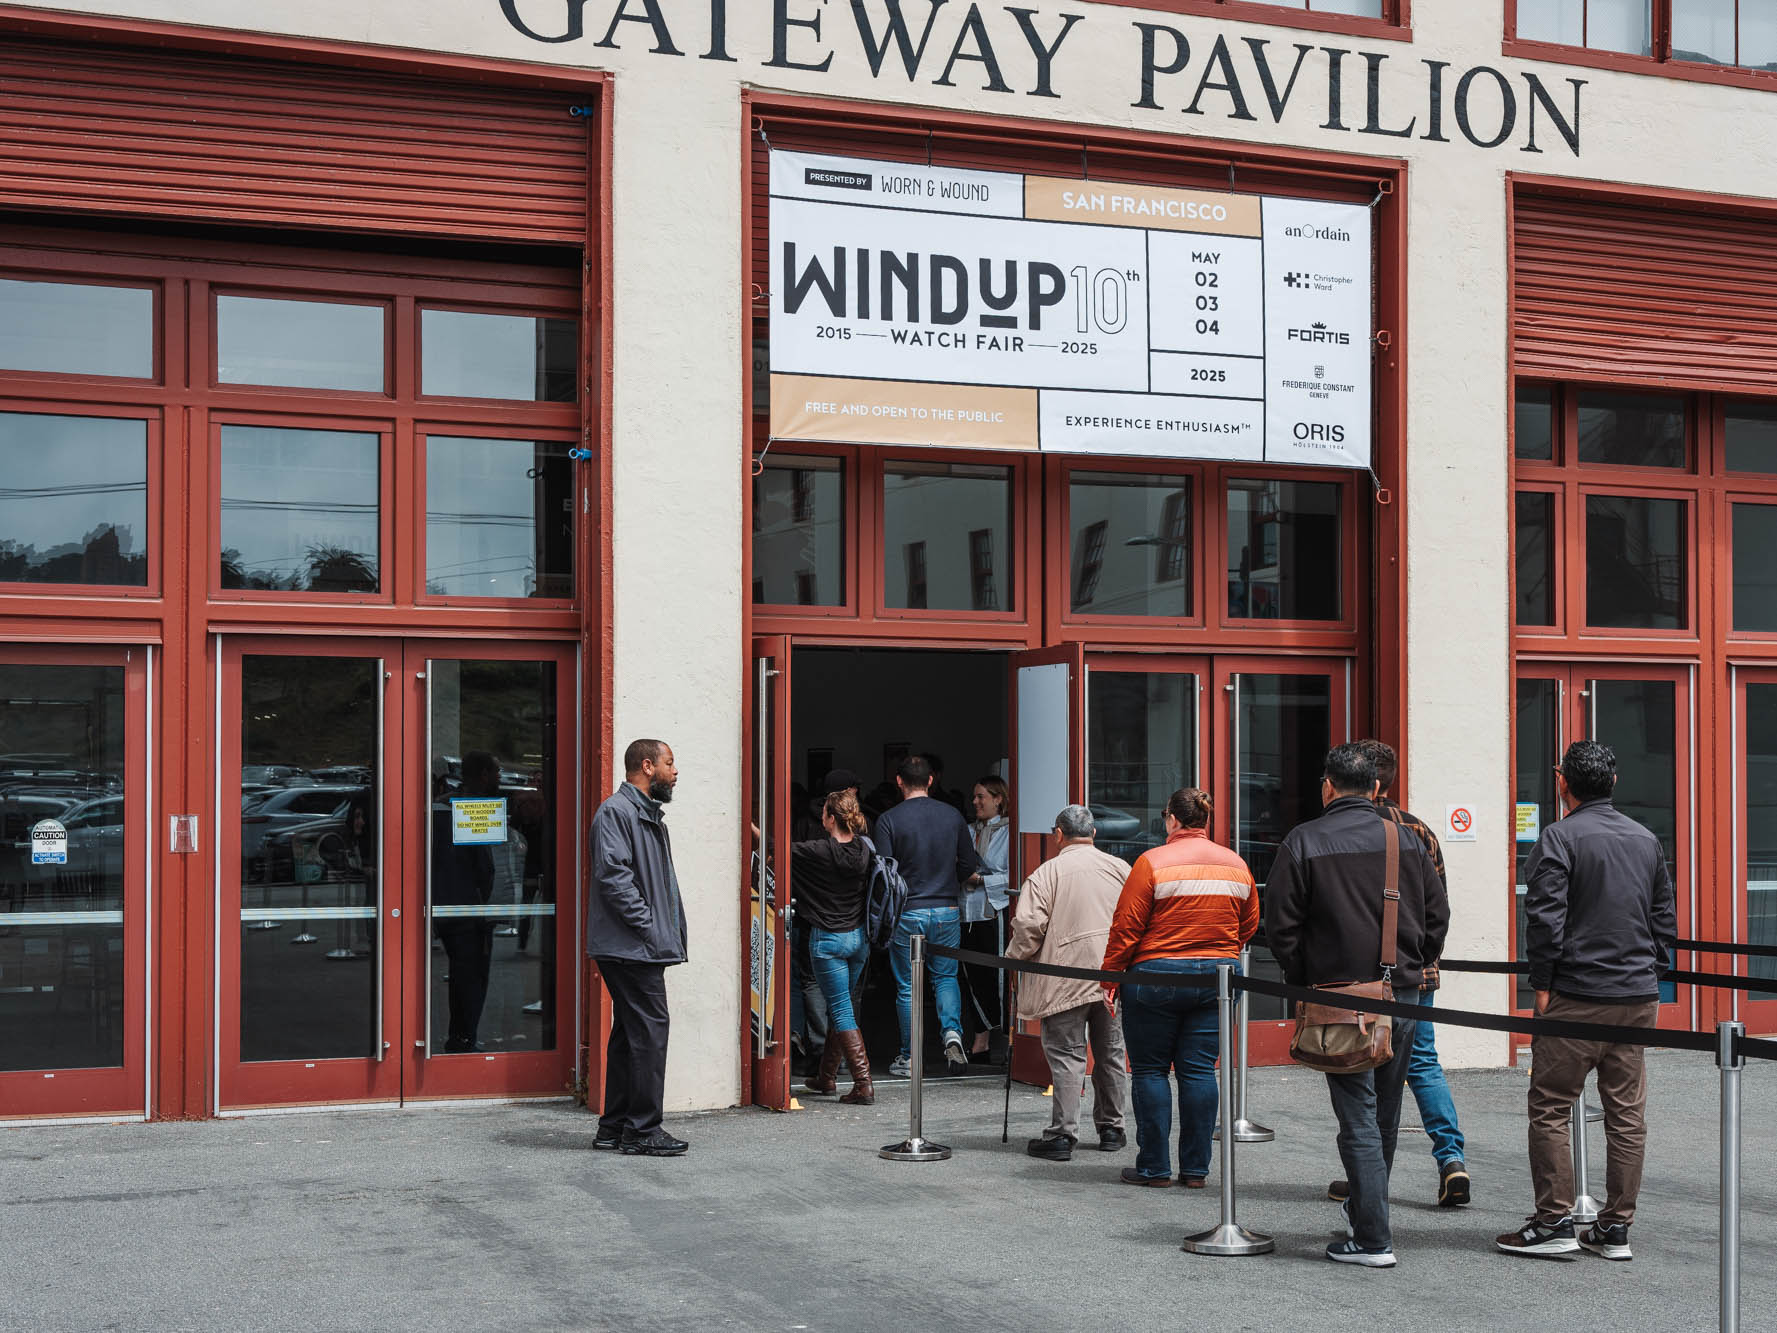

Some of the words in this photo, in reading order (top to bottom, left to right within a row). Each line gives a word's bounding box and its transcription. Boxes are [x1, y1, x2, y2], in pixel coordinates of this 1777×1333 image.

[1130, 21, 1589, 158] PAVILION
[810, 172, 855, 185] PRESENTED
[856, 176, 868, 186] BY
[881, 175, 922, 196] WORN
[927, 180, 936, 197] &
[940, 181, 989, 202] WOUND
[1062, 191, 1105, 212] SAN
[1111, 196, 1228, 222] FRANCISCO
[1191, 251, 1221, 265] MAY
[1194, 271, 1219, 288] 02
[1313, 274, 1353, 284] Christopher
[1313, 283, 1332, 291] Ward
[1195, 295, 1219, 312] 03
[1195, 319, 1220, 335] 04
[816, 325, 852, 340] 2015
[890, 328, 967, 349] WATCH
[976, 334, 1024, 352] FAIR
[1061, 341, 1098, 355] 2025
[1287, 328, 1350, 345] FORTIS
[1190, 368, 1226, 382] 2025
[1282, 380, 1321, 390] FREDERIQUE
[1322, 383, 1355, 393] CONSTANT
[805, 401, 837, 414] FREE
[840, 403, 869, 416] AND
[871, 406, 907, 418] OPEN
[910, 407, 928, 419] TO
[931, 409, 955, 421] THE
[958, 410, 1004, 423] PUBLIC
[1065, 415, 1151, 430] EXPERIENCE
[1293, 422, 1345, 442] ORIS
